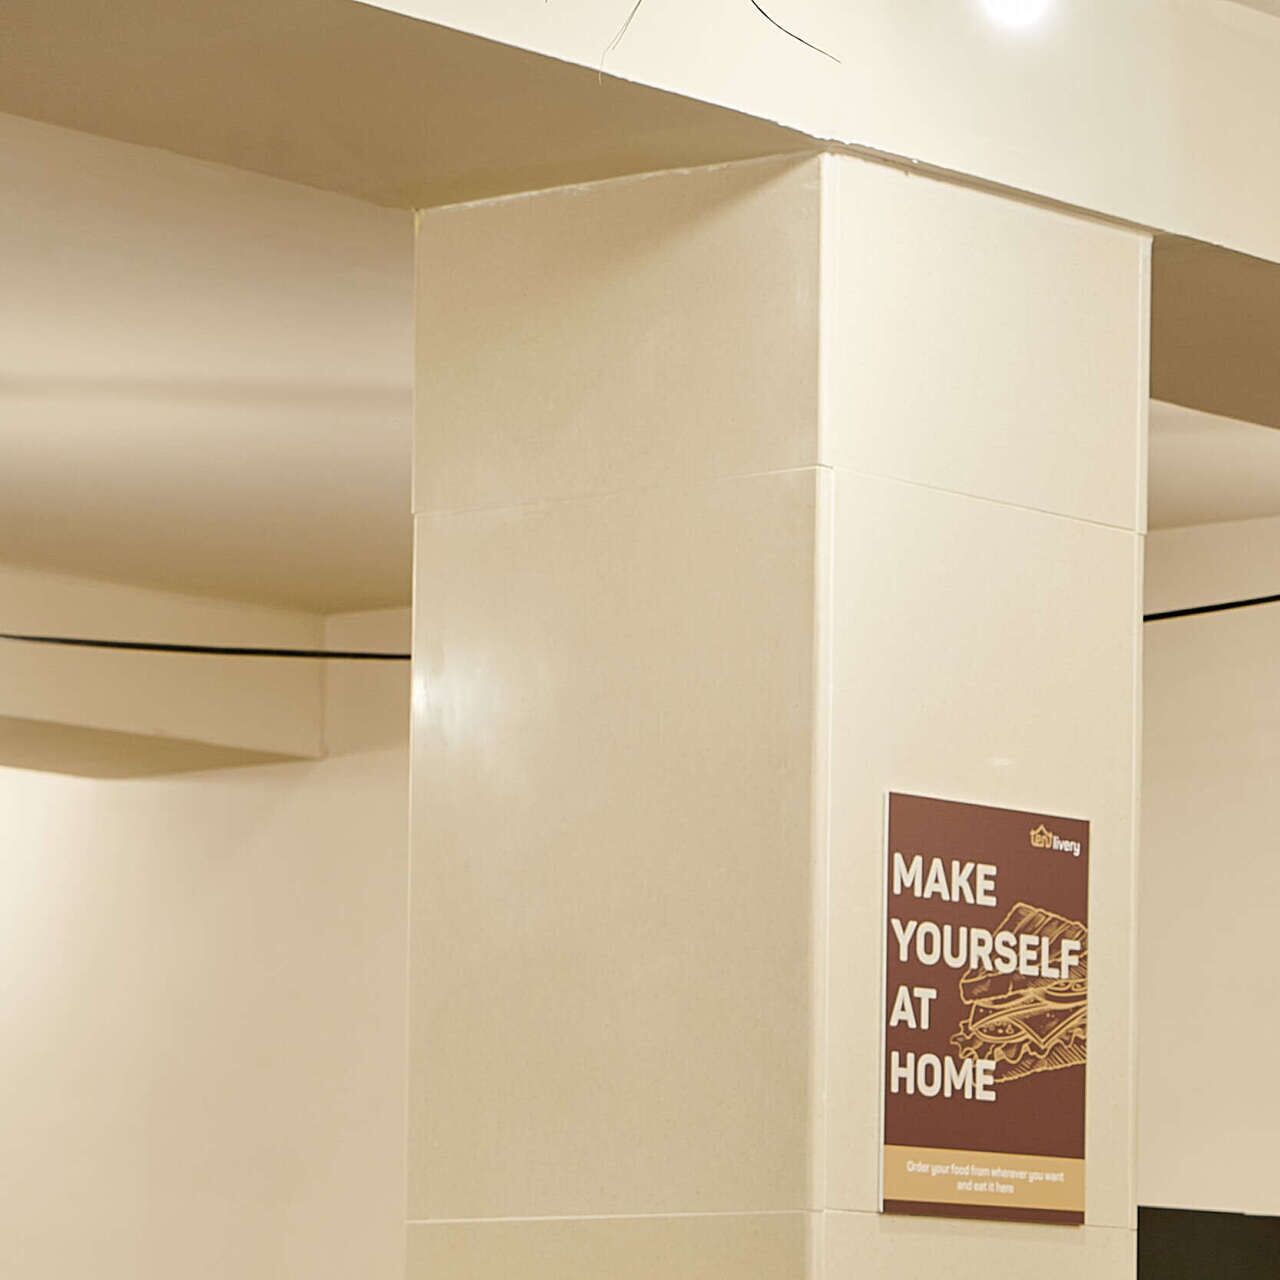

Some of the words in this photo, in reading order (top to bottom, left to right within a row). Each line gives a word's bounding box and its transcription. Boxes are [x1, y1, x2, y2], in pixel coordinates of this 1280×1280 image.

[893, 852, 997, 907] MAKE
[891, 918, 1081, 980] YOURSELF
[889, 985, 937, 1030] AT
[891, 1051, 997, 1101] HOME
[906, 1160, 930, 1173] Order
[931, 1164, 950, 1176] your
[951, 1163, 970, 1176] food
[971, 1165, 990, 1177] from
[1028, 1171, 1044, 1183] you
[1045, 1172, 1065, 1182] want
[956, 1179, 972, 1191] and
[995, 1182, 1015, 1194] here
